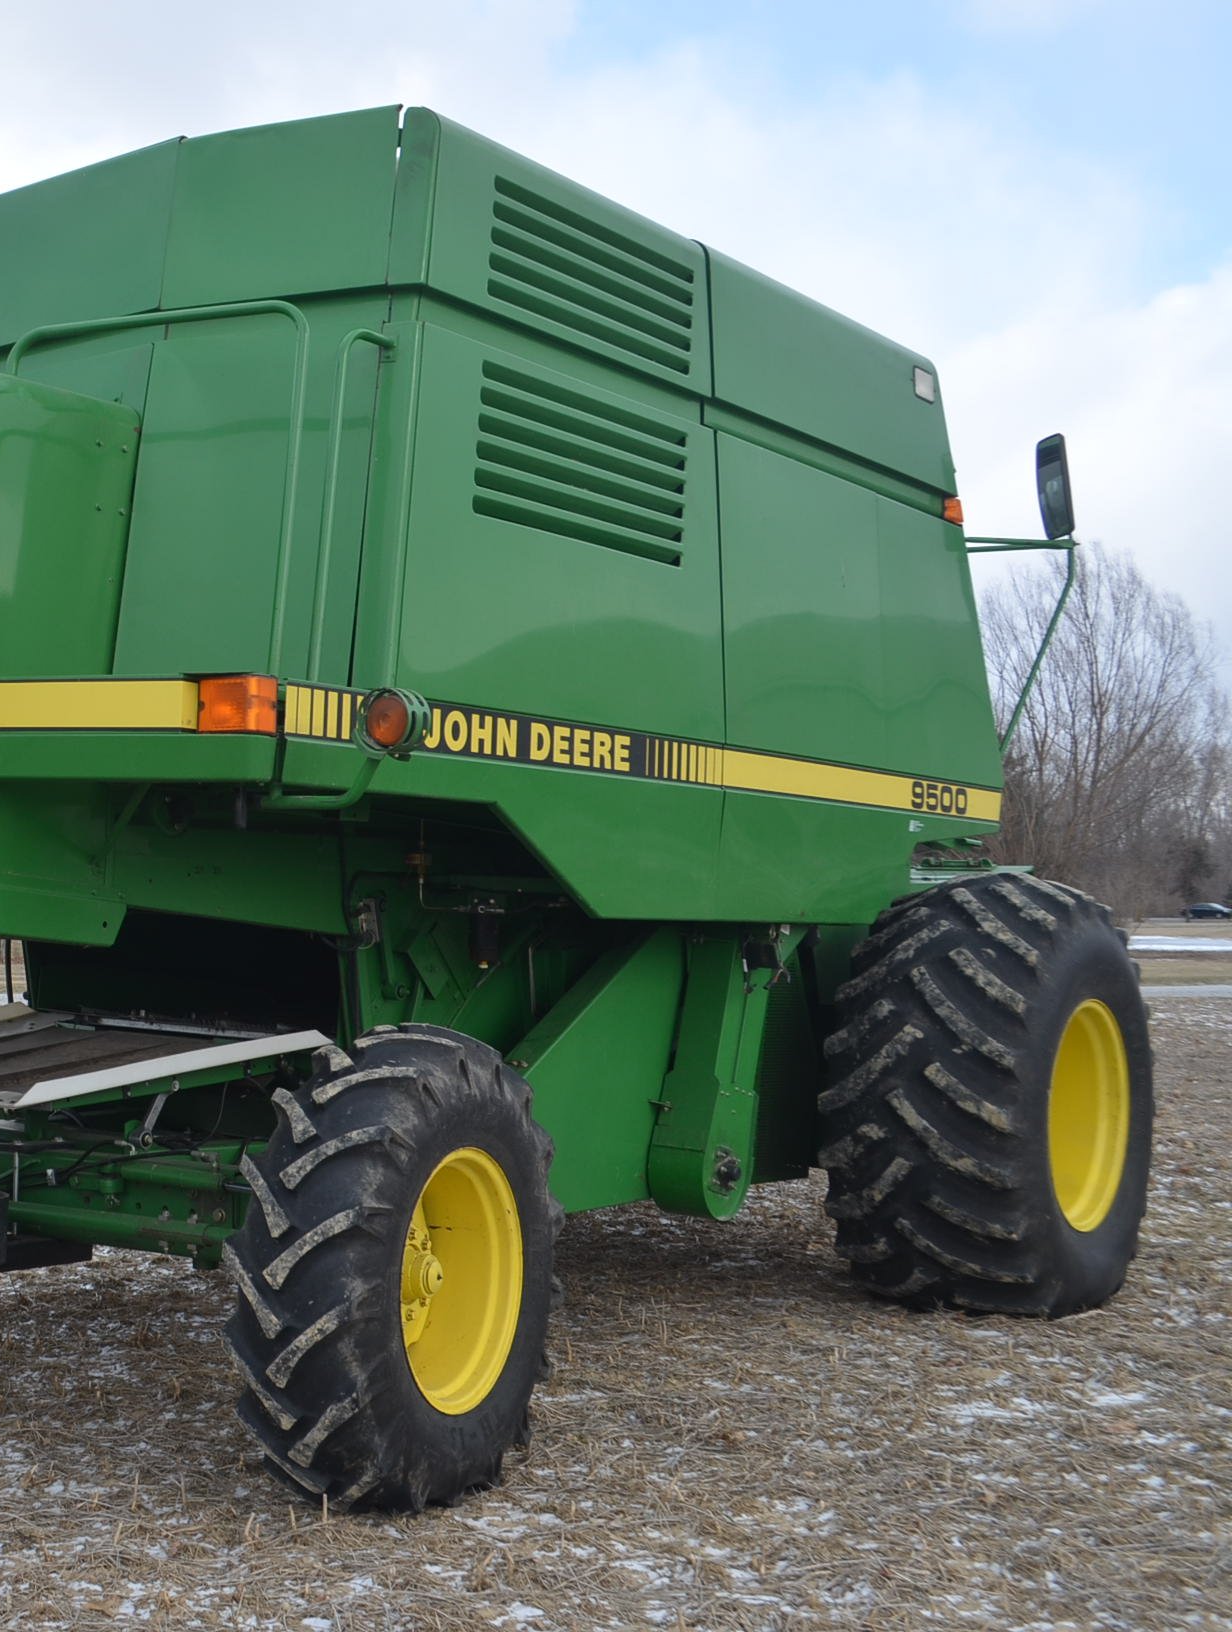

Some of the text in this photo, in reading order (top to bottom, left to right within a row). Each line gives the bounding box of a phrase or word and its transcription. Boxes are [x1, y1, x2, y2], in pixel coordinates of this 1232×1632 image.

[423, 708, 631, 772] JOHN DEERE
[911, 781, 967, 815] 9500
